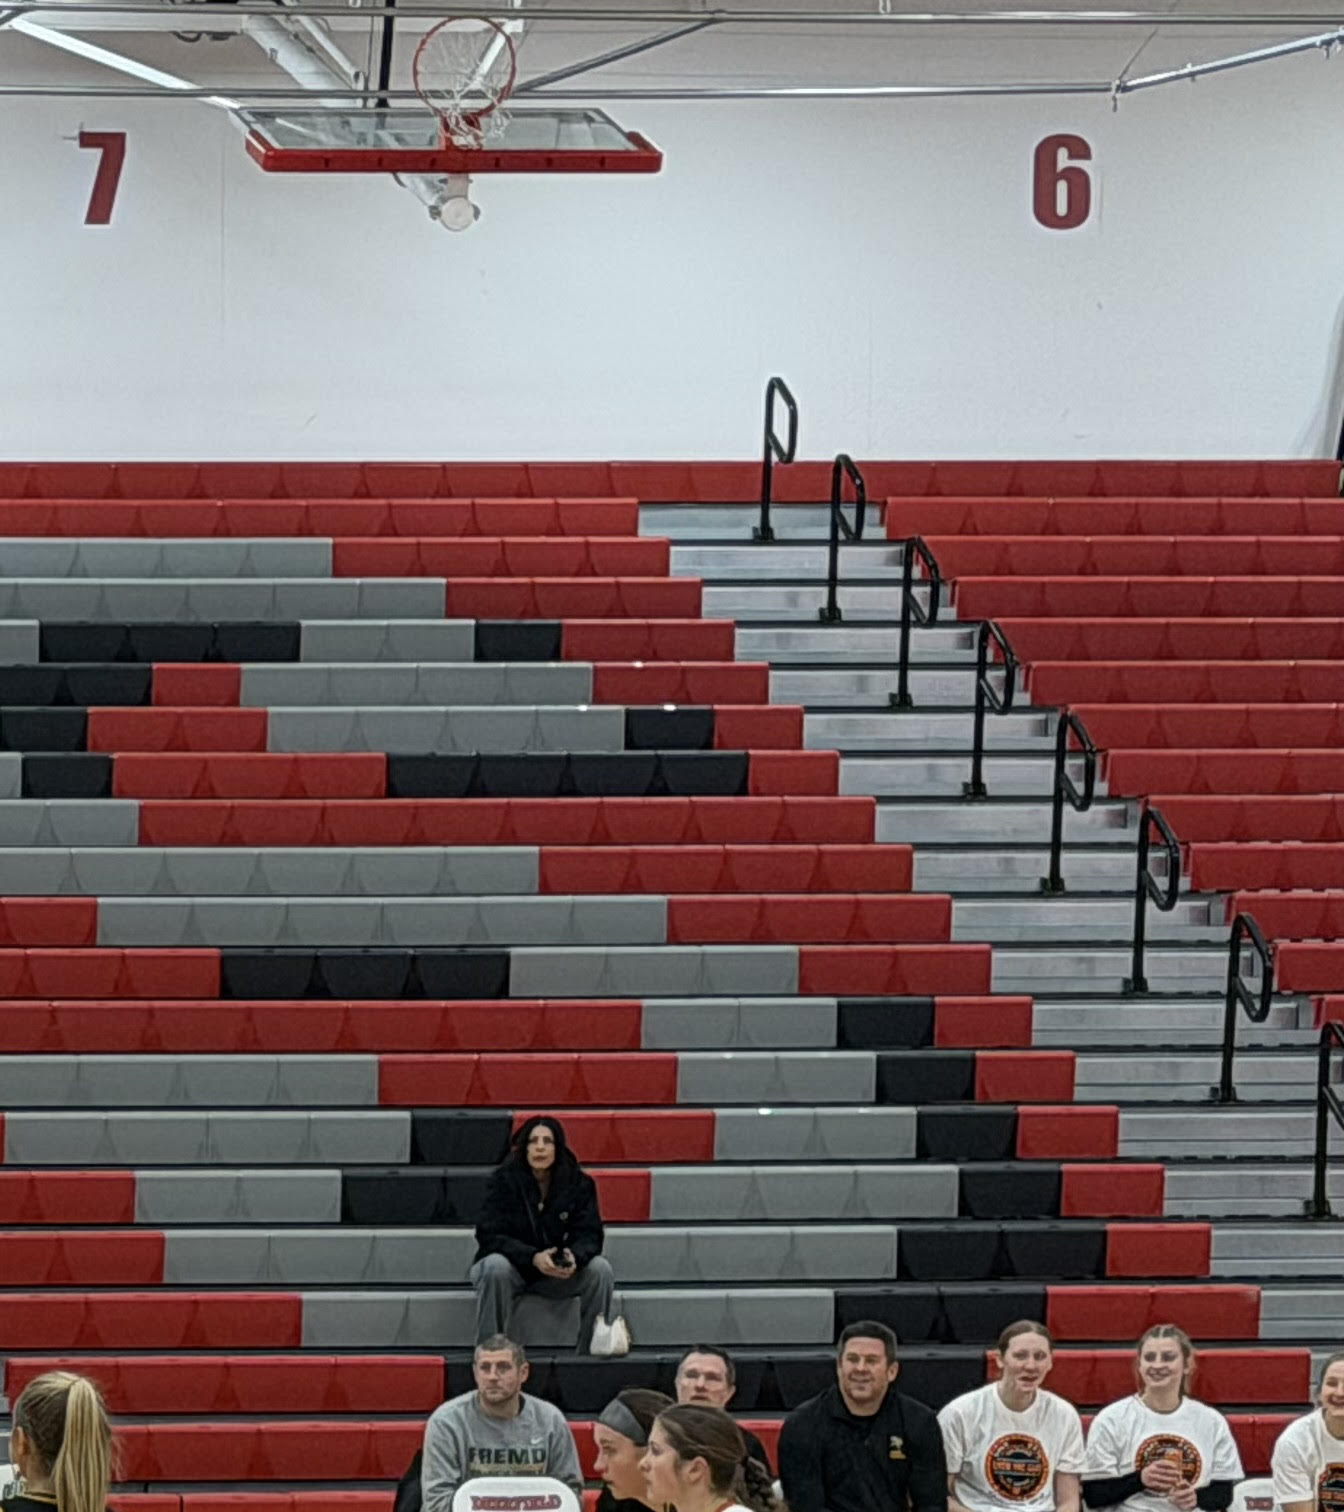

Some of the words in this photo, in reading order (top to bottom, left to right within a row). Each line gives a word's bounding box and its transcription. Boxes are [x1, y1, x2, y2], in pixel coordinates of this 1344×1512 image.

[78, 131, 127, 226] 7
[1032, 133, 1092, 230] 6
[468, 1447, 547, 1465] FREMD
